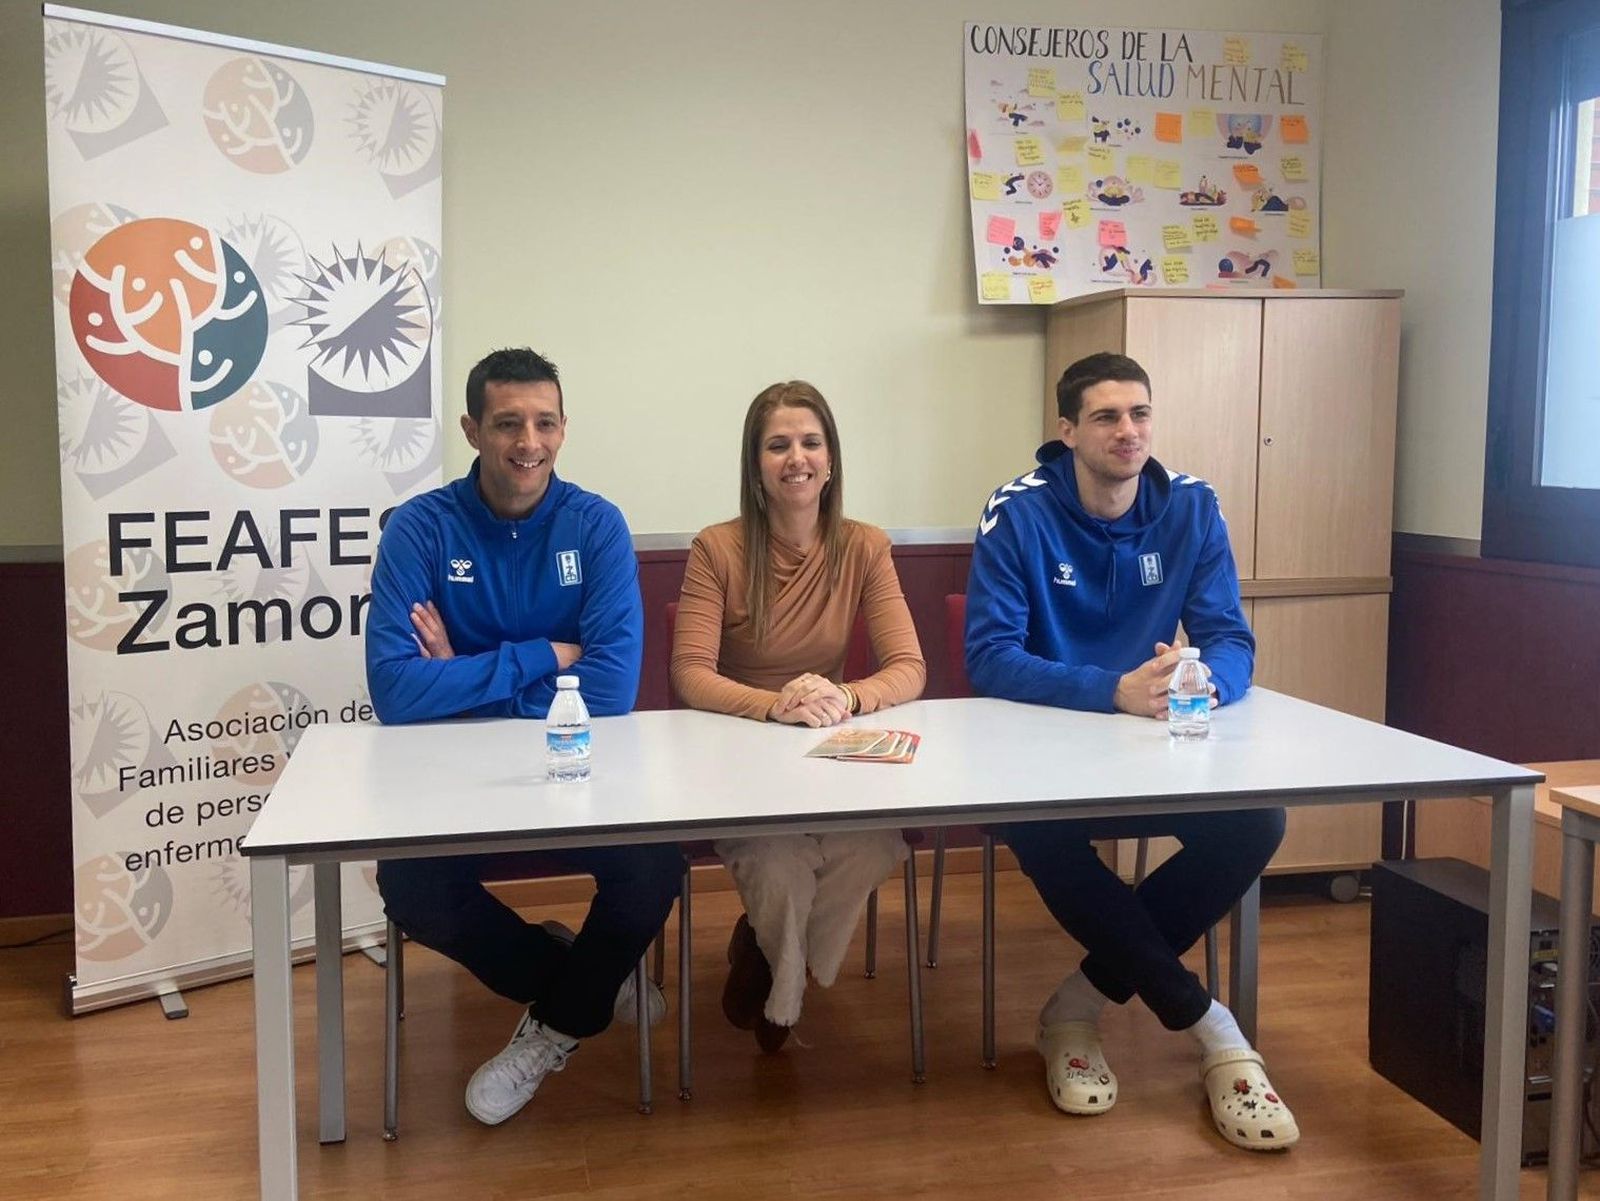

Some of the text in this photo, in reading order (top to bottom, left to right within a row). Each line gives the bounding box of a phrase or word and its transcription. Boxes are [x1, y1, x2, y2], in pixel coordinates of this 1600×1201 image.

[970, 25, 1109, 59] CONSEJEROS
[1121, 31, 1148, 61] DE
[1160, 33, 1193, 62] LA
[1087, 60, 1175, 98] SALUD
[1186, 64, 1305, 106] MENTAL
[108, 506, 398, 577] FEAFE
[164, 700, 373, 745] Asociación de
[118, 754, 275, 792] Familiares
[145, 792, 271, 828] de pers
